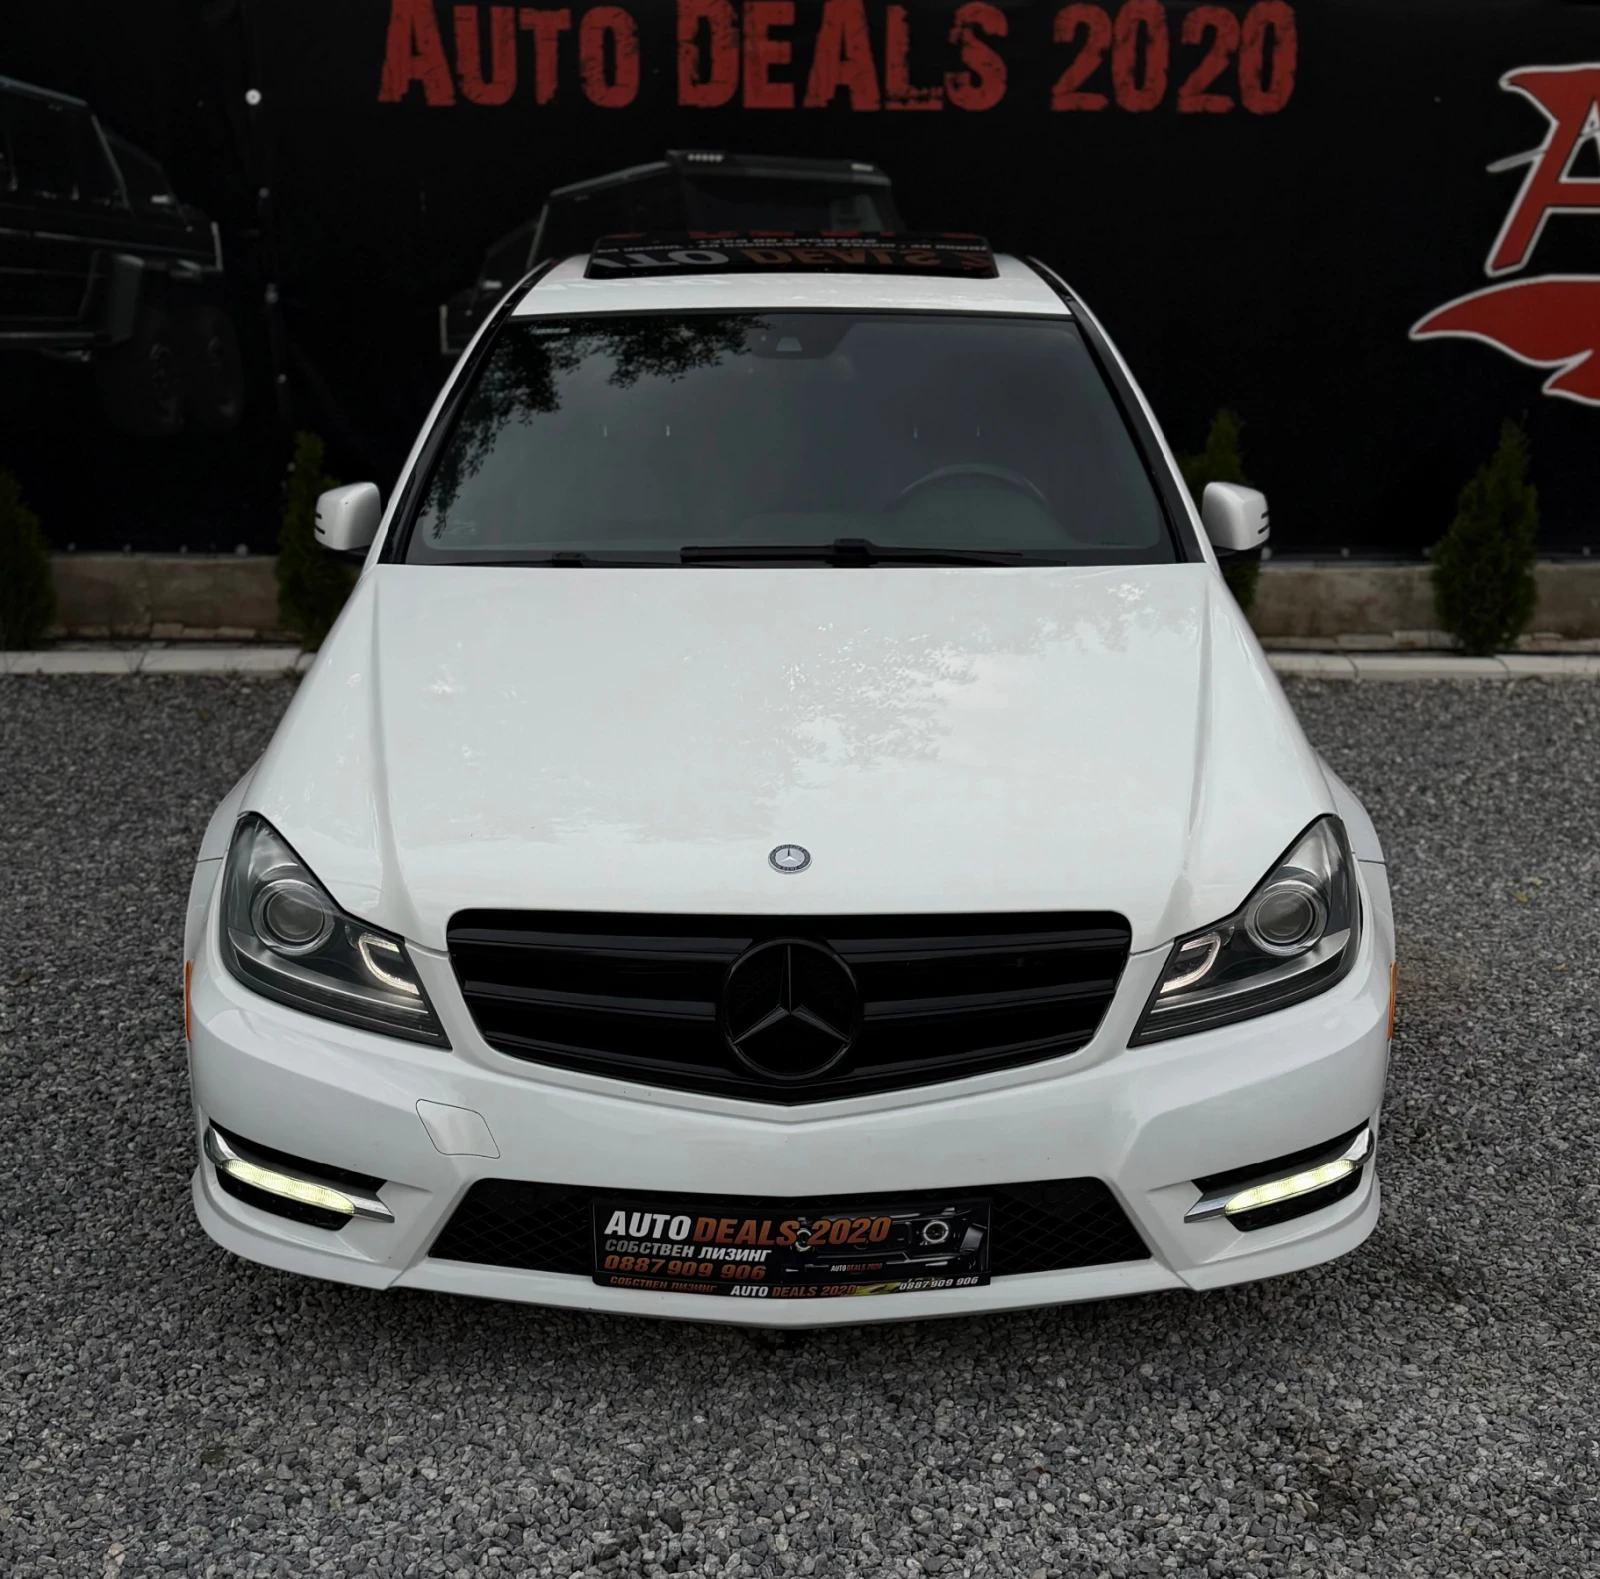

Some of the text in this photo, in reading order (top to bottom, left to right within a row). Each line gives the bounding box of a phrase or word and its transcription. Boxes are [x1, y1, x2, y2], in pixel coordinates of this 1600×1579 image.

[378, 0, 1298, 115] AUTO DEALS 2020
[604, 1210, 893, 1246] AUTO DEALS 2020
[605, 1239, 772, 1262] СОБСТВЕН ЛИЗИНГ
[604, 1254, 767, 1280] 0887 909 906
[610, 1276, 668, 1289] СОБСТВЕН
[730, 1284, 857, 1298] AUTO DEALS 2020
[899, 1276, 979, 1290] 0887 909 906
